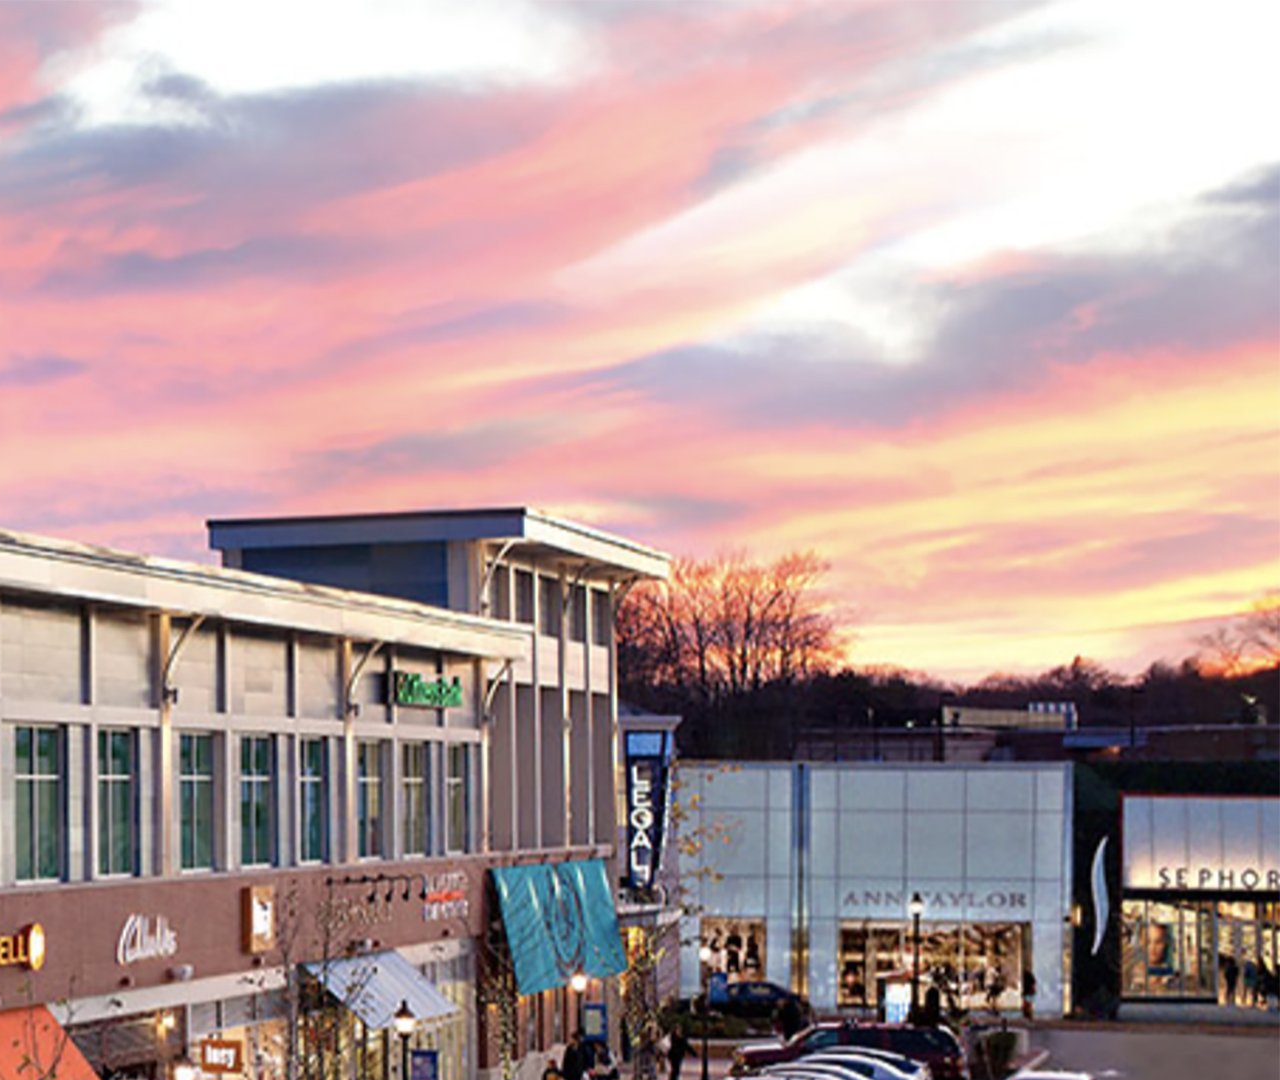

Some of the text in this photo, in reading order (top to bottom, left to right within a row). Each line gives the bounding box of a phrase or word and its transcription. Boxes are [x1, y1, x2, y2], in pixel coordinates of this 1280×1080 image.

[630, 764, 653, 871] LEGAL
[843, 890, 1028, 908] ANN AYLOR
